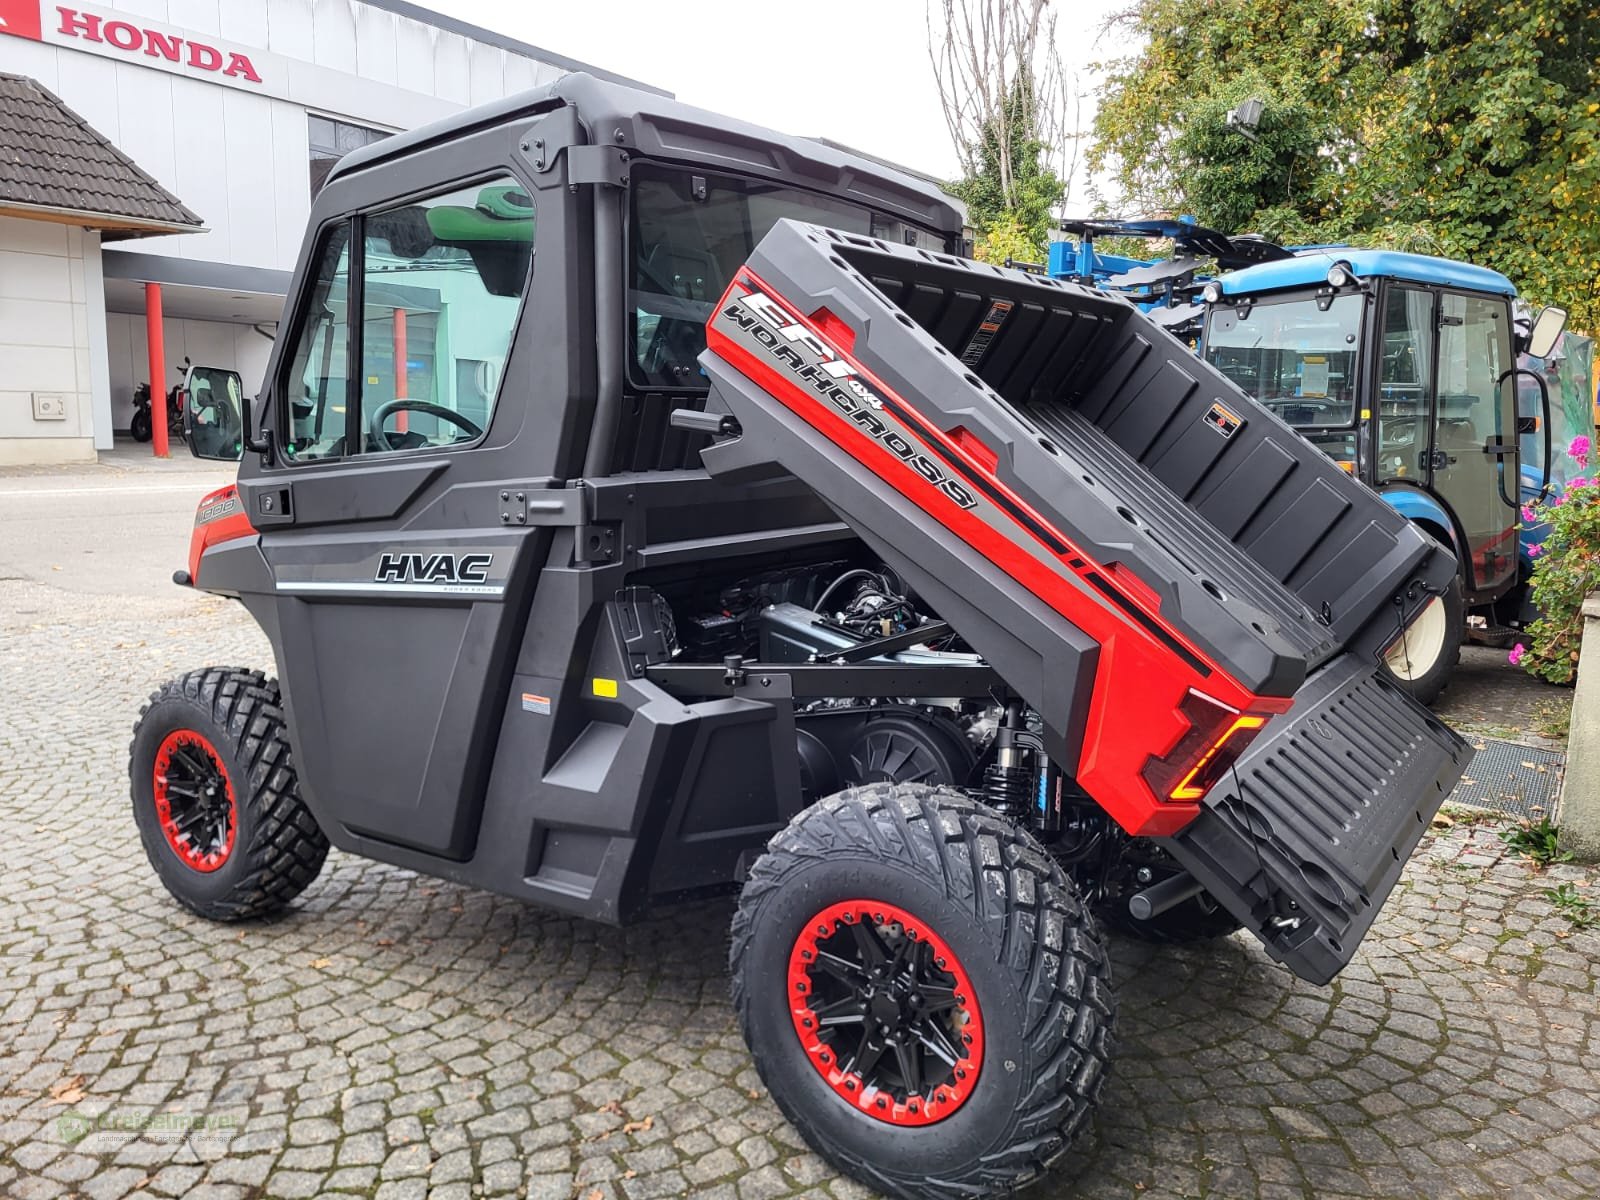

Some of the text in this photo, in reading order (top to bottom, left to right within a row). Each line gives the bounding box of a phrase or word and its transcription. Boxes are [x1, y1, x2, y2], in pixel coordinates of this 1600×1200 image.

[56, 6, 262, 83] HONDA
[722, 302, 978, 510] WORKCROSS
[374, 553, 494, 584] HVAC
